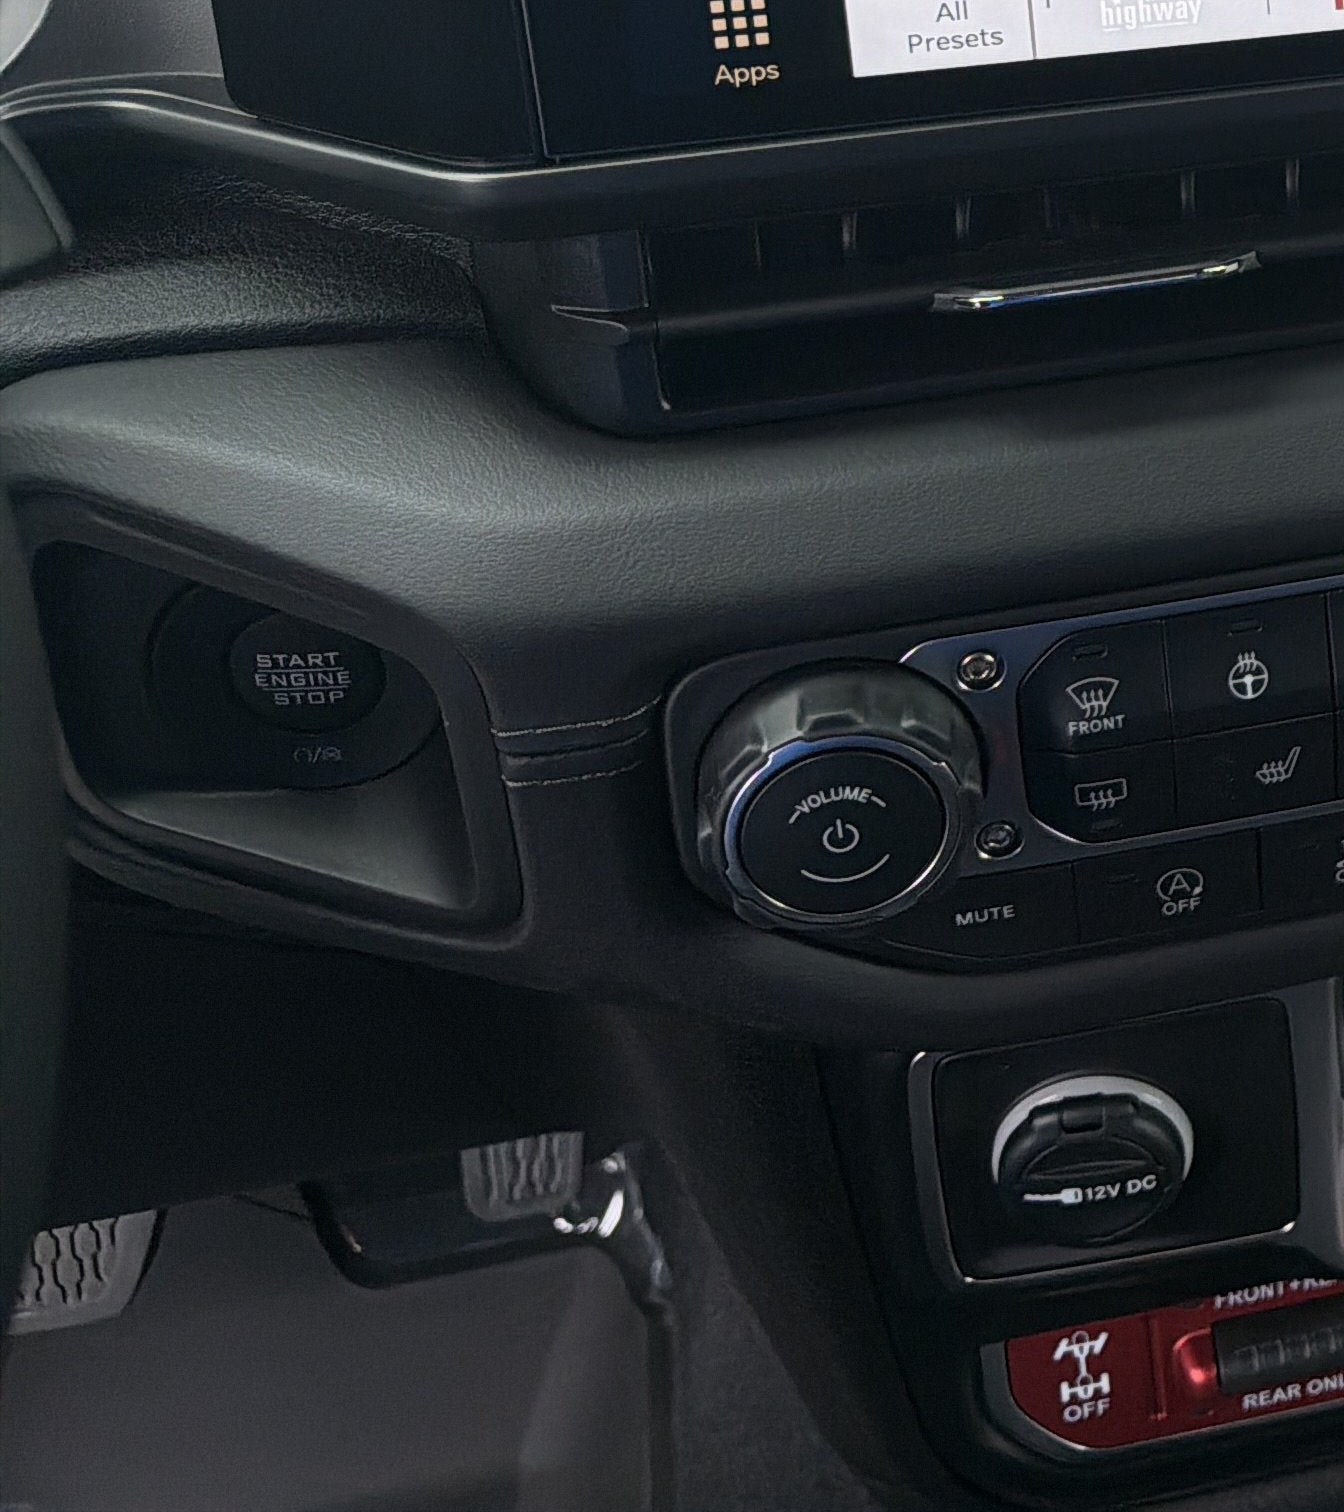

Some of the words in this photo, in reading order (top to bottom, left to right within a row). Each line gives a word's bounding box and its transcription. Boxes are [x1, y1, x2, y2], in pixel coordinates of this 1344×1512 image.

[936, 1, 969, 23] All
[908, 29, 1004, 54] Presets
[715, 62, 780, 88] Apps
[256, 652, 340, 669] START
[254, 670, 351, 688] ENGINE
[274, 689, 345, 706] STOP
[1067, 713, 1125, 736] FRONT
[795, 786, 873, 816] VOLUME
[955, 904, 1015, 928] MUTE
[1161, 896, 1200, 916] OFF
[1084, 1182, 1121, 1202] 12V
[1126, 1174, 1157, 1195] DC
[1242, 1383, 1301, 1412] REAR
[1063, 1398, 1110, 1422] OFF
